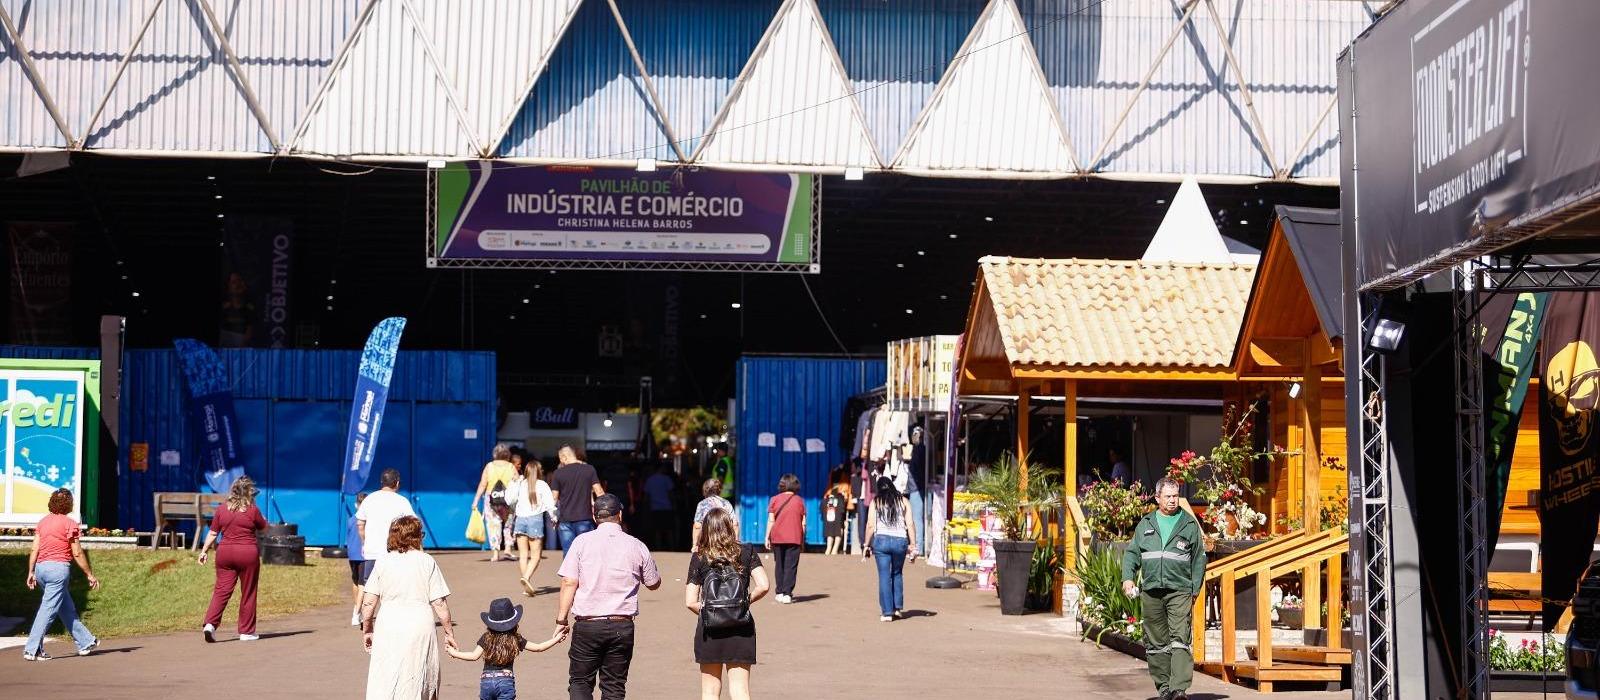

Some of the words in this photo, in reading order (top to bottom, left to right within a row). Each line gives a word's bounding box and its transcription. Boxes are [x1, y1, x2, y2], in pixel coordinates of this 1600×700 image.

[580, 177, 649, 193] PAVILHÃO
[652, 180, 672, 193] DE
[1428, 172, 1466, 215] SUSPENSION
[1471, 158, 1489, 192] BODY
[1490, 148, 1506, 181] LIFT
[507, 188, 616, 216] INDÚSTRIA
[620, 195, 633, 215] E
[637, 192, 744, 217] COMÉRCIO
[557, 217, 610, 228] CHRISTINA
[612, 218, 650, 228] HELENA
[652, 219, 693, 229] BARROS
[271, 233, 289, 324] OBJETIVO
[536, 406, 574, 423] Bull
